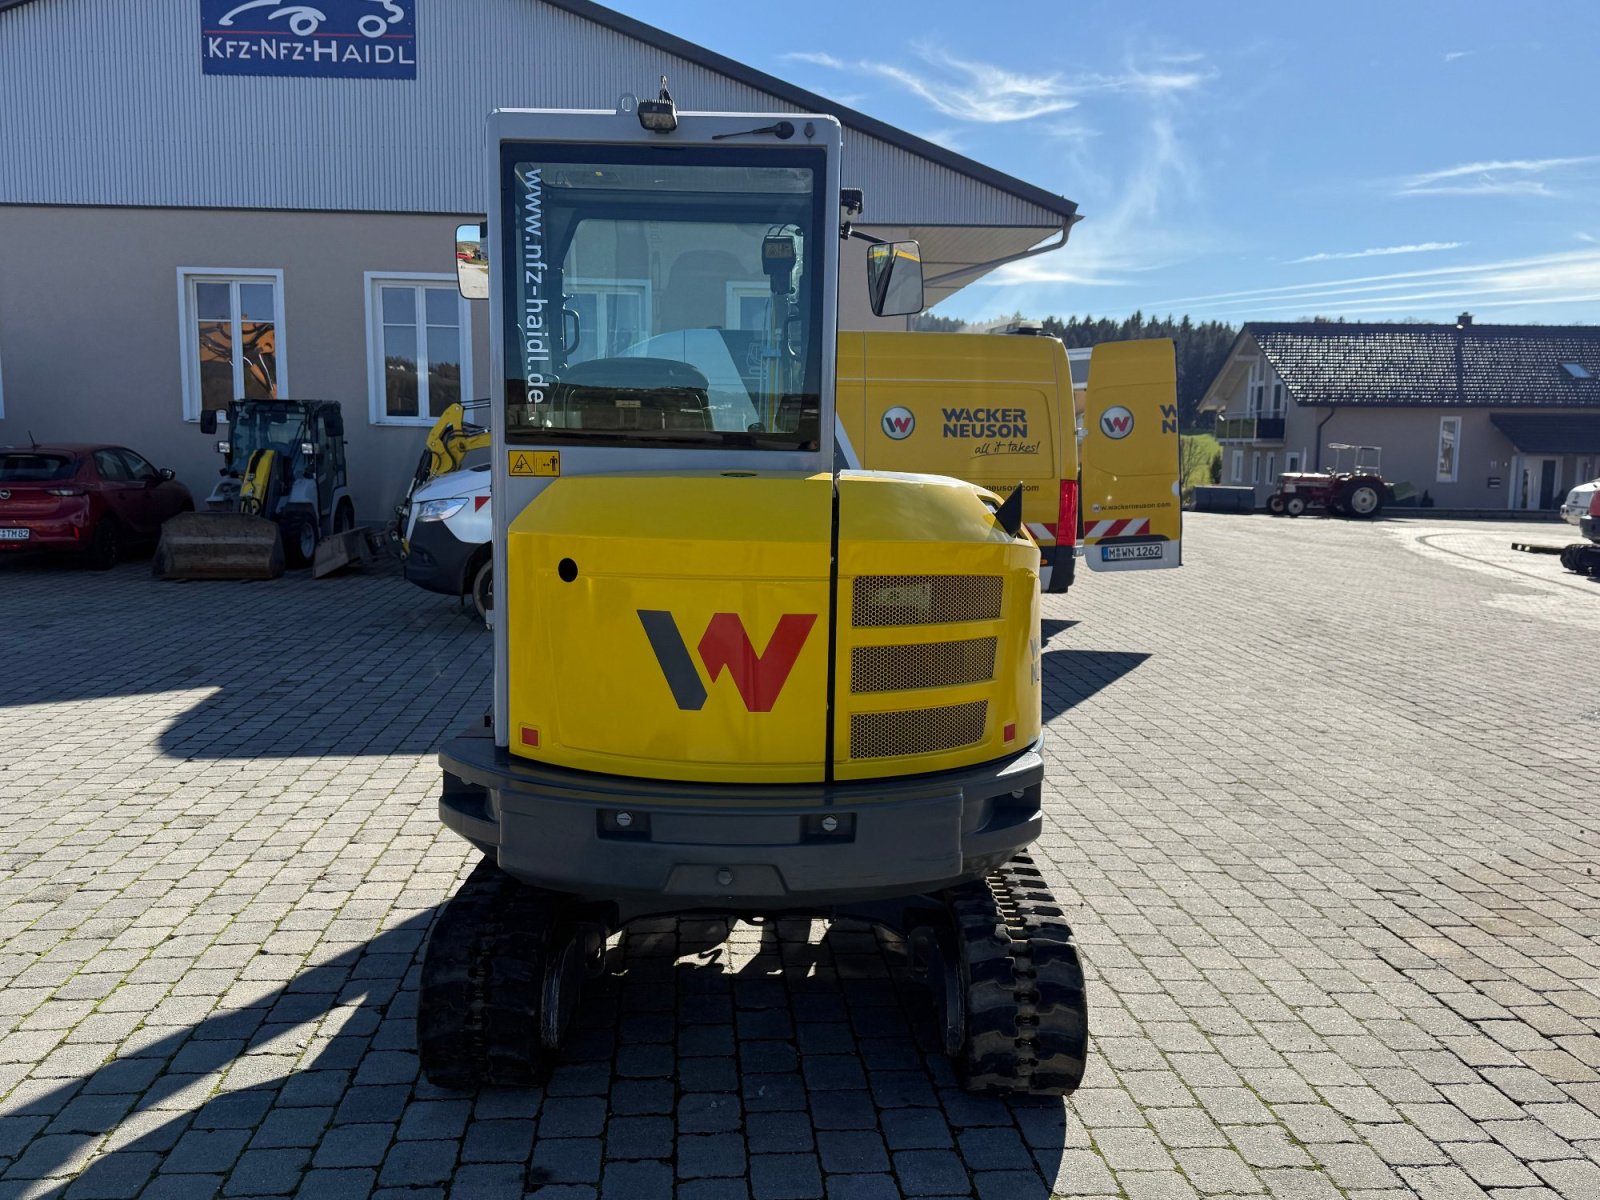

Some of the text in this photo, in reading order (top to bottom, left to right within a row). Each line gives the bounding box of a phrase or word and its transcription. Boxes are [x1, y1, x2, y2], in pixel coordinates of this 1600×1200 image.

[524, 168, 550, 405] www.nfz-haidl.de
[941, 407, 1027, 423] WACKER
[943, 423, 1028, 438] NEUSON
[974, 441, 1041, 455] all it takes!
[1136, 546, 1160, 557] 1262
